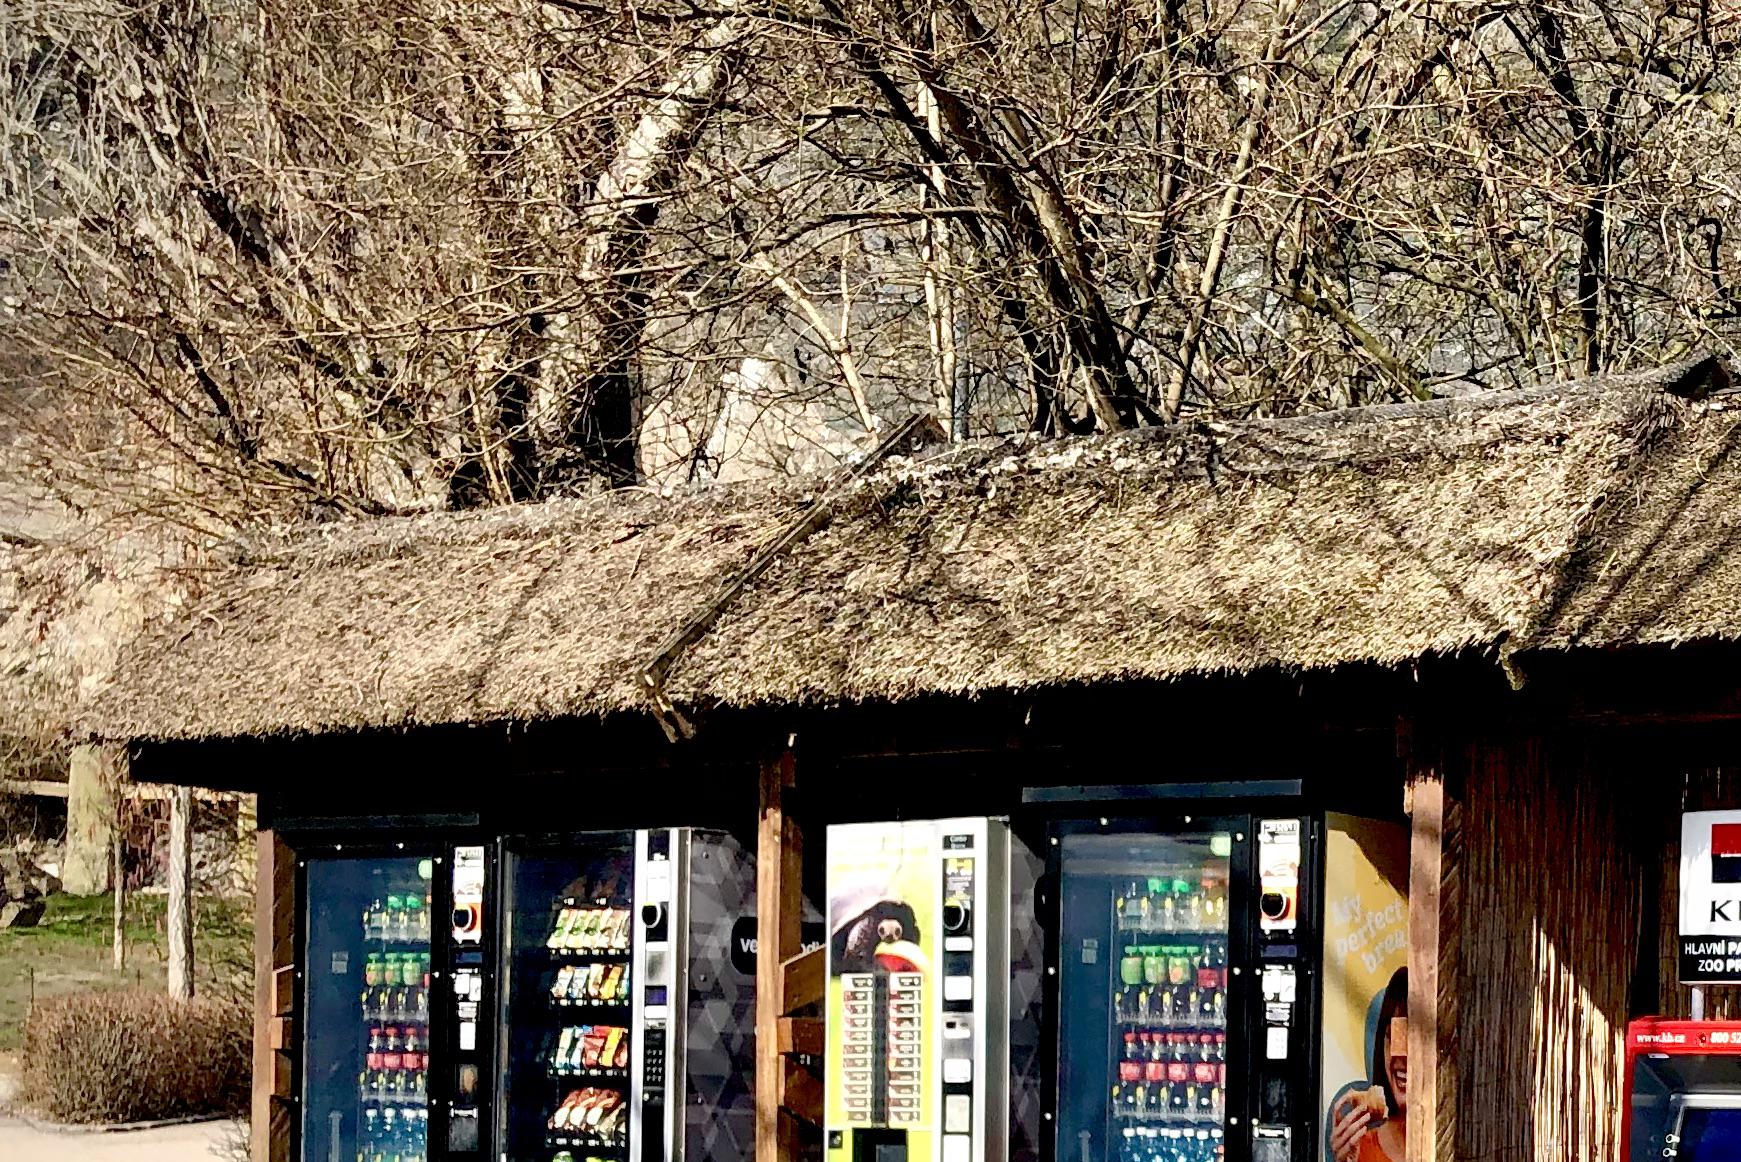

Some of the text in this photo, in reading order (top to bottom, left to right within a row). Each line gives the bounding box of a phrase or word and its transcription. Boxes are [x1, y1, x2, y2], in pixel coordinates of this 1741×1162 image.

[1335, 898, 1404, 967] perfect
[1684, 939, 1726, 955] HLAVNÍ
[1697, 959, 1725, 973] ZOO
[1636, 1031, 1686, 1044] www.kb.cz
